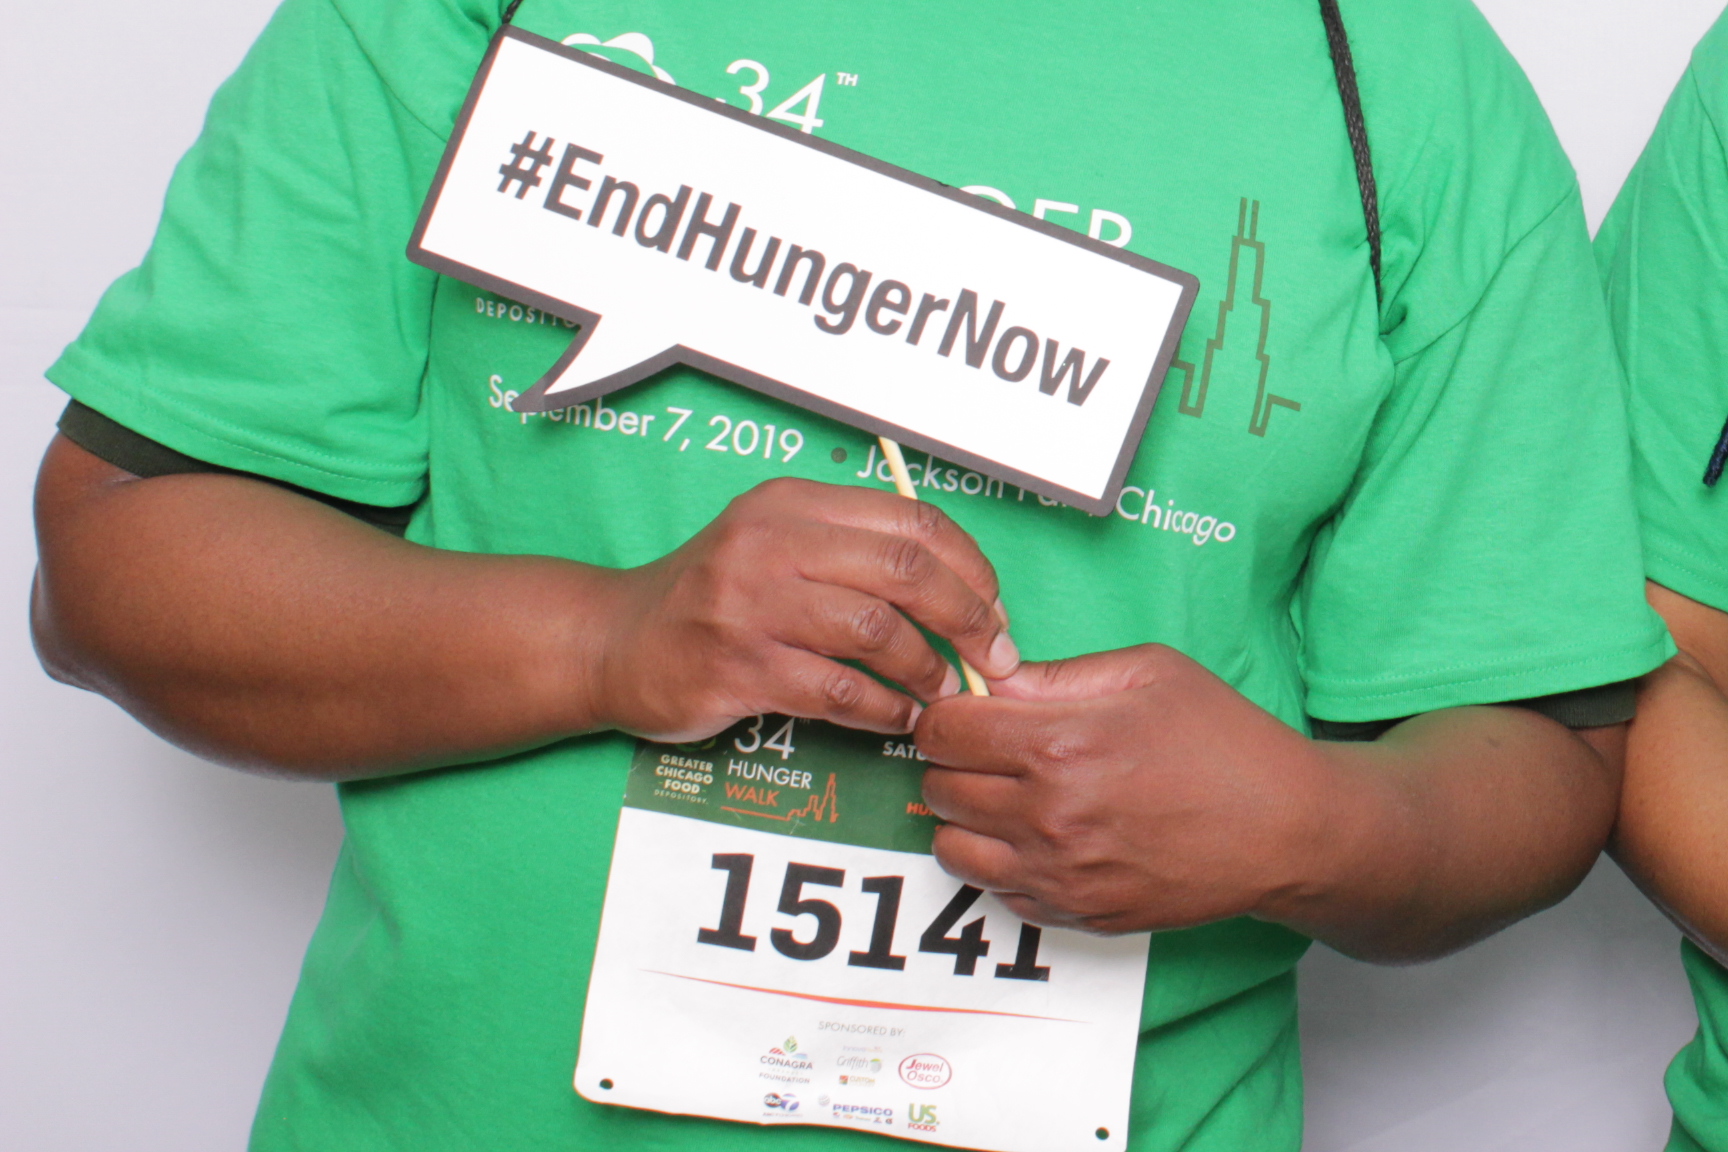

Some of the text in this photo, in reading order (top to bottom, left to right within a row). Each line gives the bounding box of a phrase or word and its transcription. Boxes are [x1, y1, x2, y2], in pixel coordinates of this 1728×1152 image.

[496, 130, 1111, 408] #EndHungerNow
[663, 406, 694, 452] 7,
[705, 415, 804, 463] 2019
[1115, 485, 1236, 546] Chicago
[660, 754, 714, 773] GREATER
[655, 765, 714, 786] CHICAGO
[727, 758, 813, 790] HUNGER
[664, 779, 701, 795] FOOD
[725, 781, 780, 808] WALK
[696, 852, 1051, 982] 15141
[818, 1021, 888, 1036] SPONSORED
[760, 1055, 814, 1070] CONAGRA
[906, 1059, 945, 1073] Jewel
[759, 1072, 811, 1085] FOUNDATION
[832, 1103, 894, 1117] PEPSICO
[908, 1123, 937, 1133] FOODS
